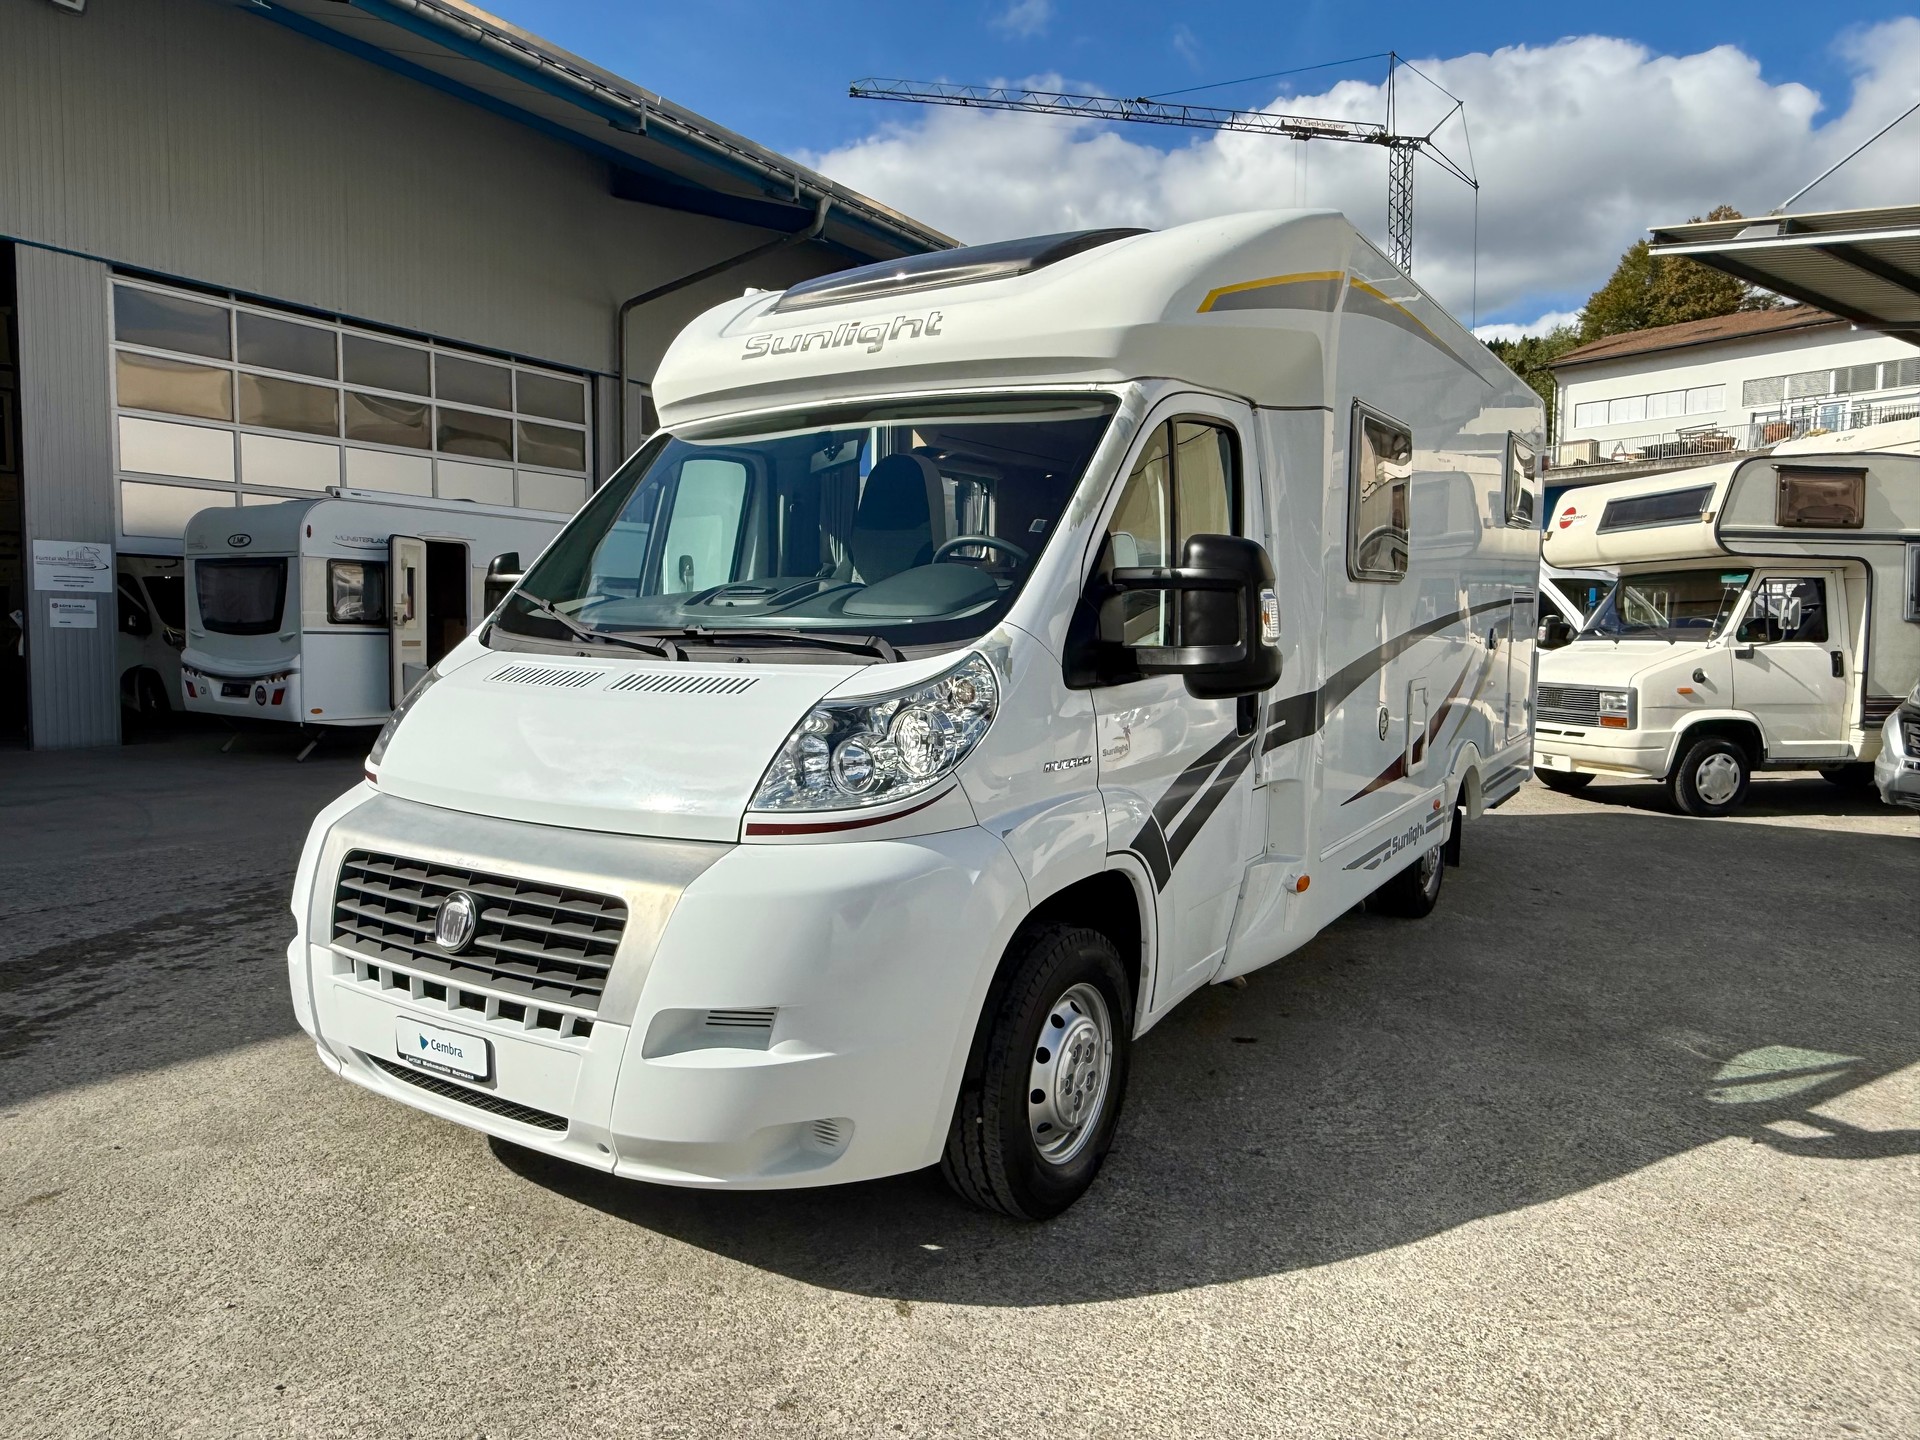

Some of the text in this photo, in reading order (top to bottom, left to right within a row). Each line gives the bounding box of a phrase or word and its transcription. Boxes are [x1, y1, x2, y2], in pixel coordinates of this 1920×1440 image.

[742, 311, 943, 360] Sunlight
[1102, 744, 1129, 757] Sunlight
[430, 1039, 463, 1058] Cembra
